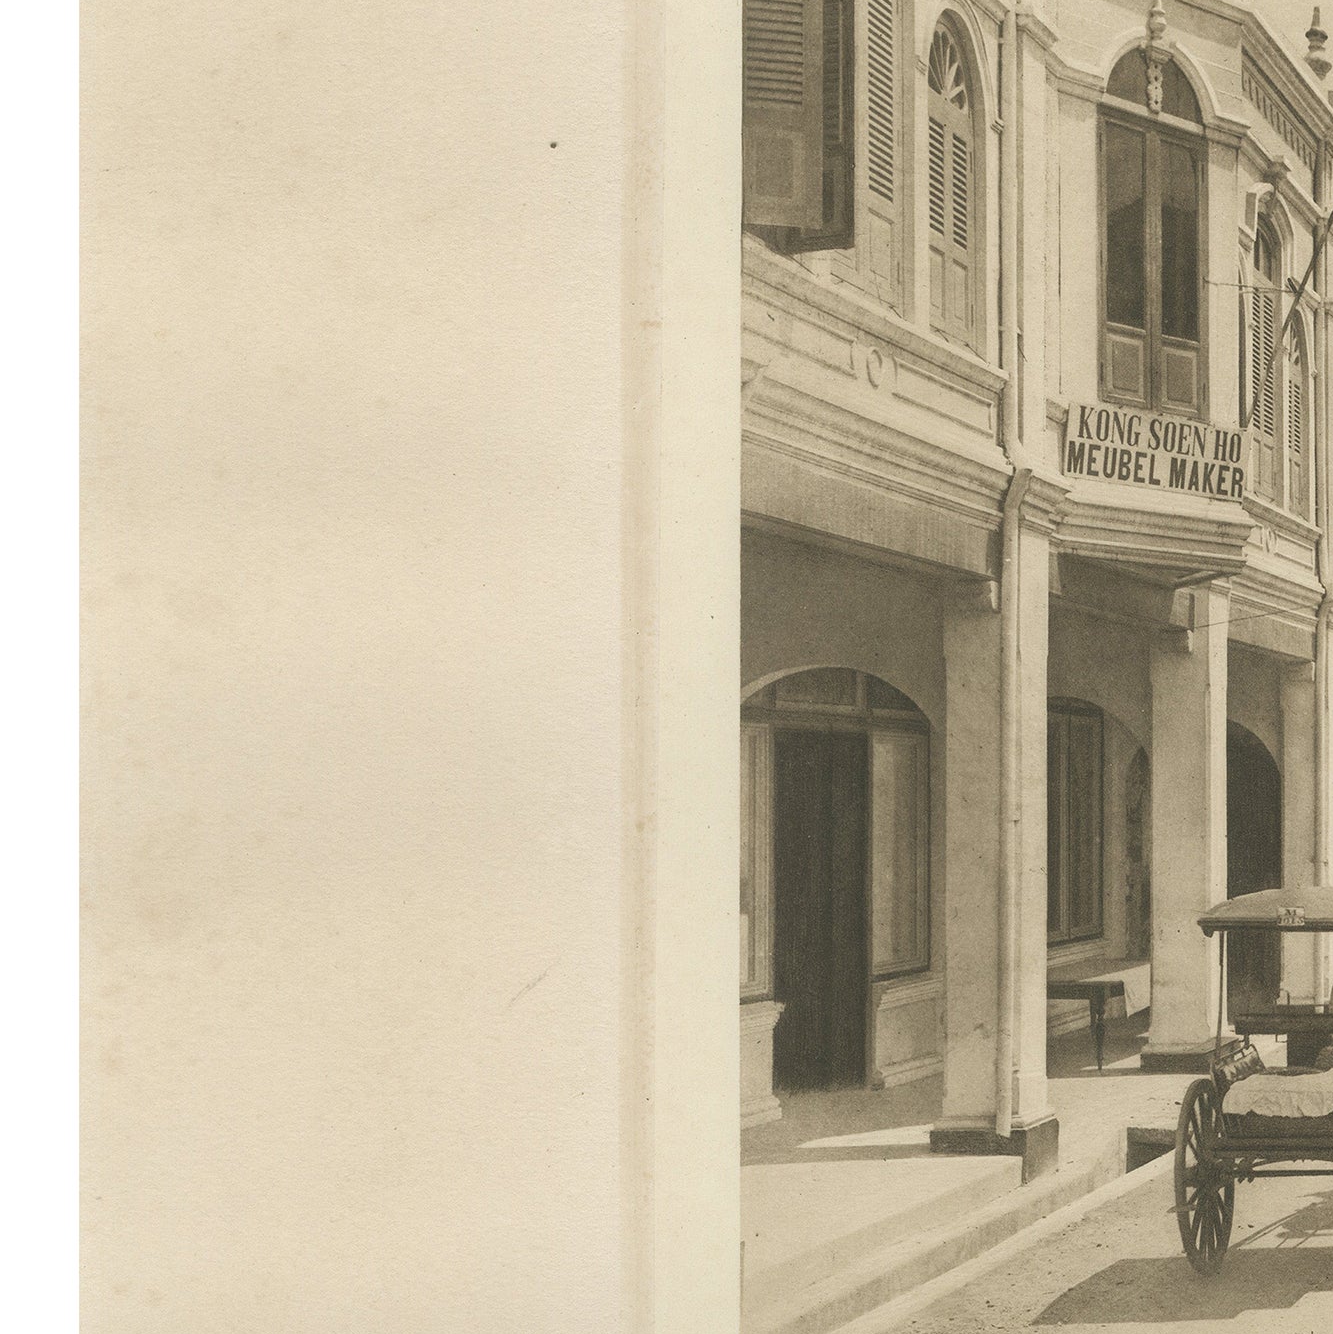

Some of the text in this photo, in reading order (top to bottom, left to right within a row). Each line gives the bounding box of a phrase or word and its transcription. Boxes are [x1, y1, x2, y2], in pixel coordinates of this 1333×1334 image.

[1077, 405, 1242, 463] KONG SOEN HO
[1067, 440, 1244, 498] MEUBEL MAKER
